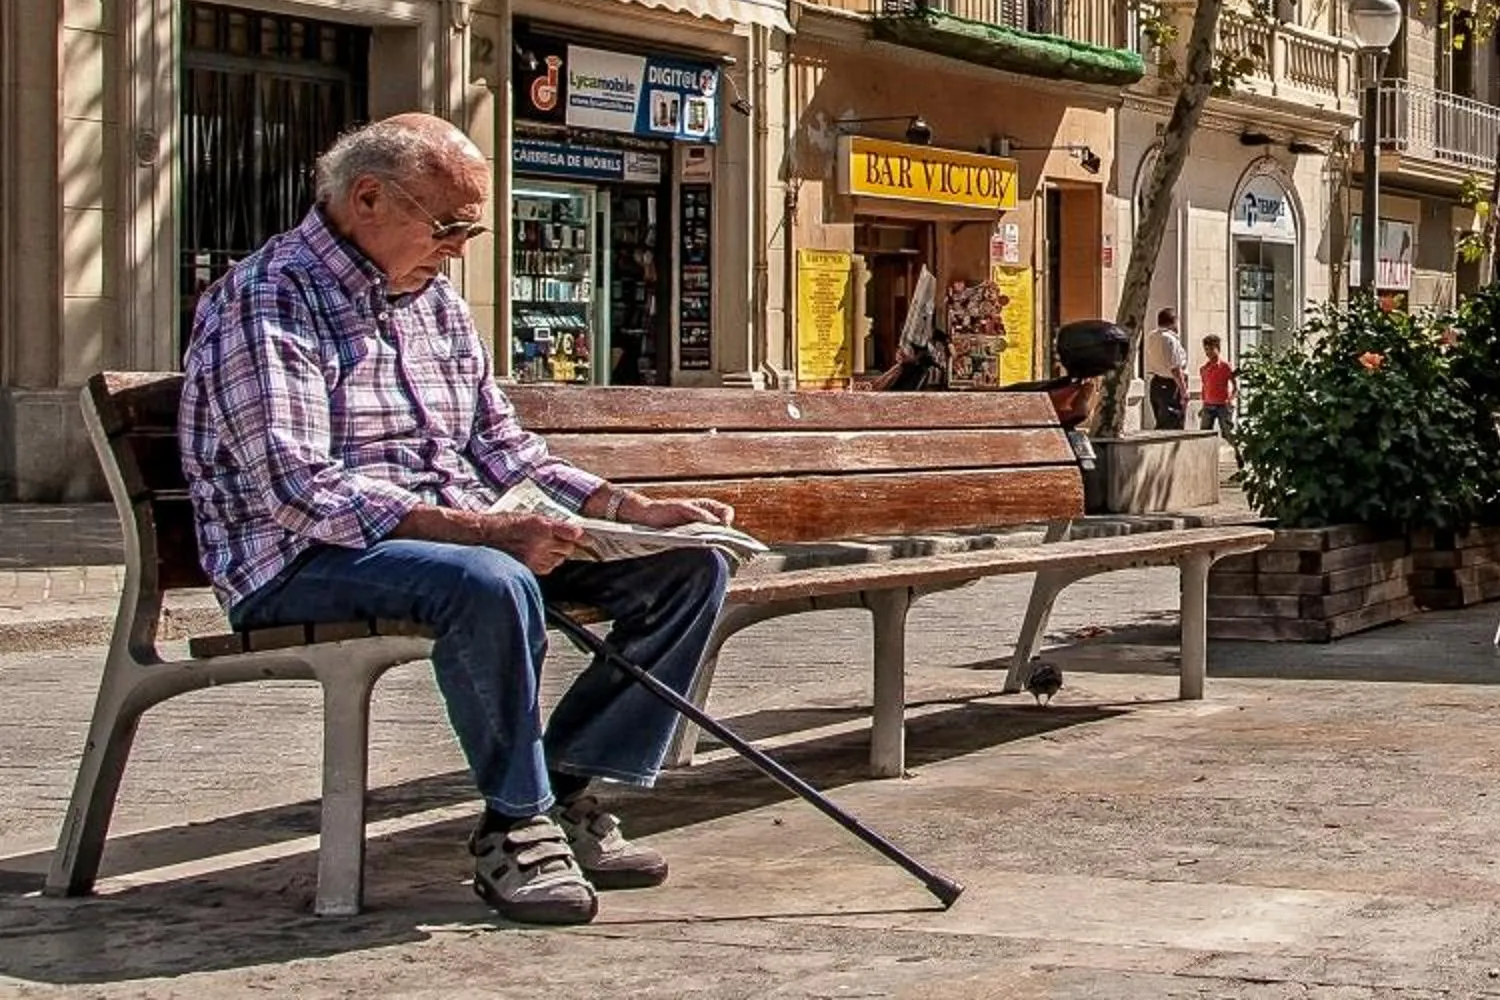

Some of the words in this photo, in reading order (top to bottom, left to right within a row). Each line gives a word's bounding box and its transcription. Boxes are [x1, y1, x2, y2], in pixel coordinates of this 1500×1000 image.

[569, 71, 635, 94] Lycamobile
[648, 65, 699, 90] DIGIT@L
[567, 154, 581, 168] DE
[865, 151, 913, 189] BAR
[921, 159, 1005, 199] VICTOR
